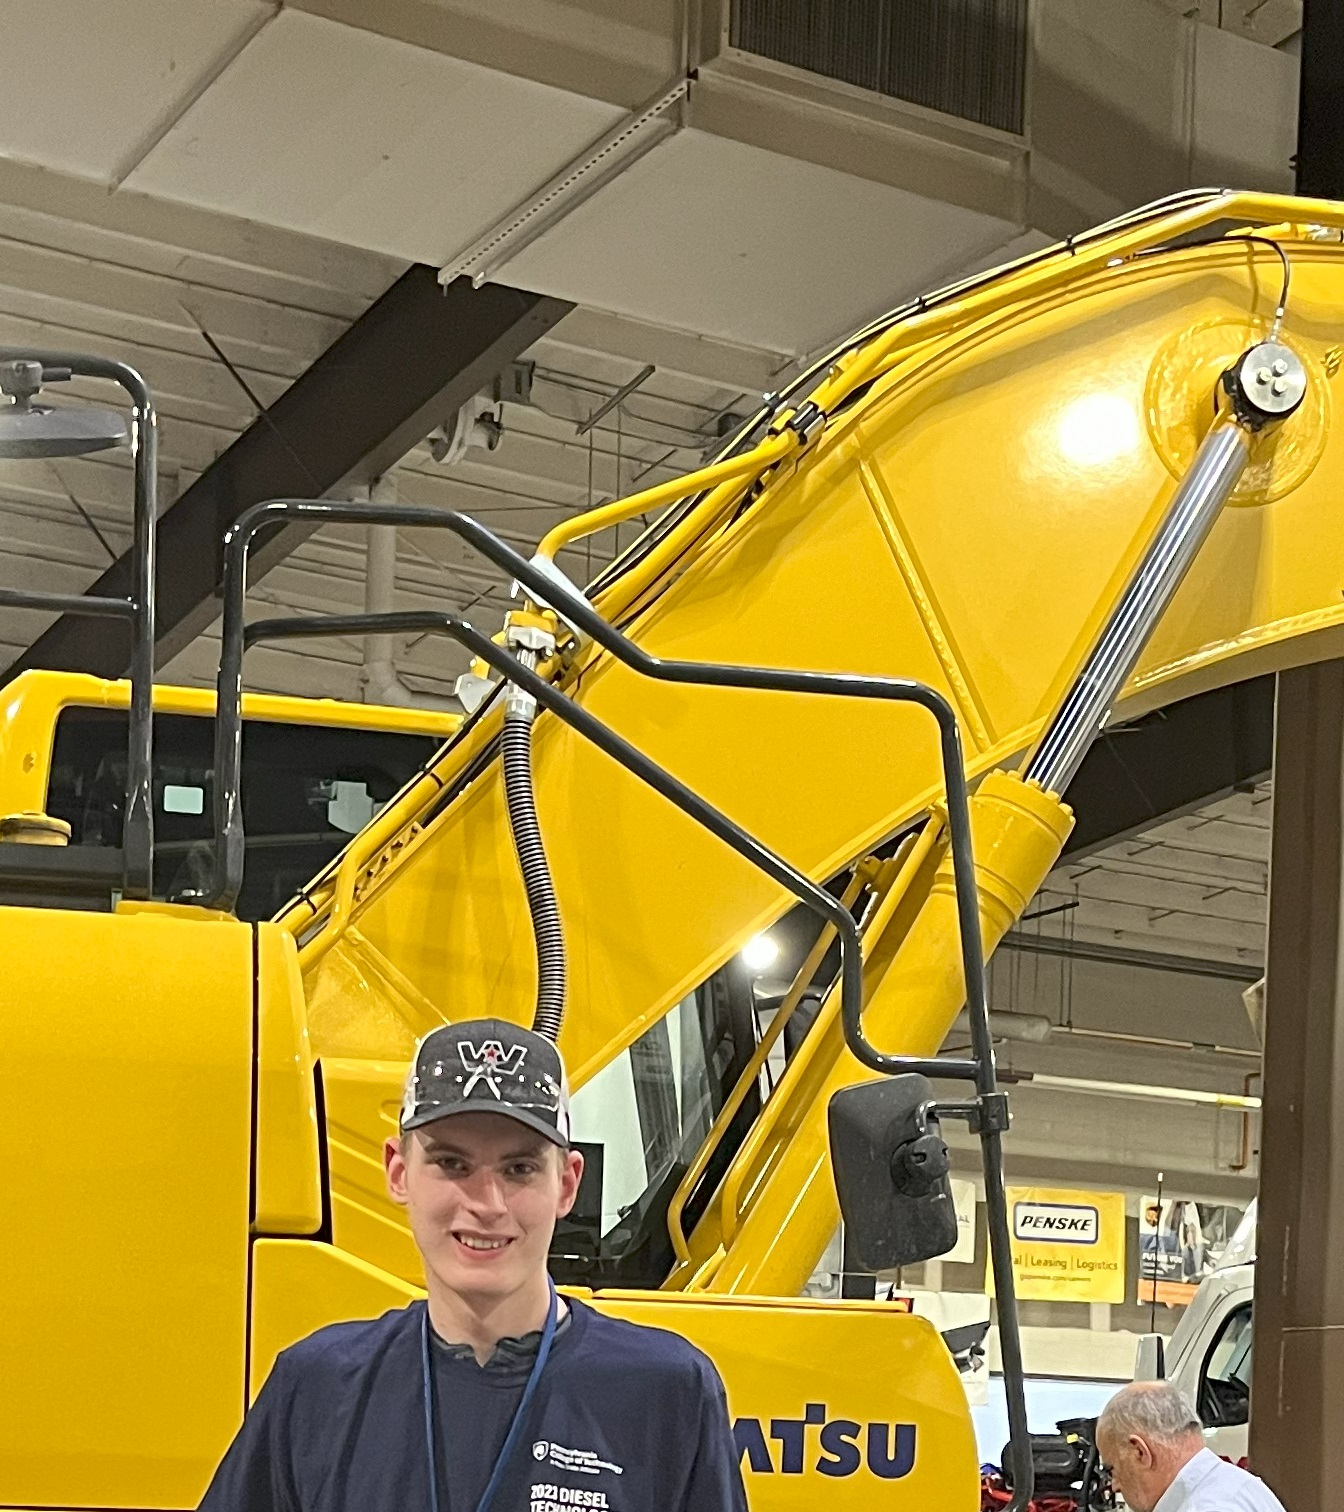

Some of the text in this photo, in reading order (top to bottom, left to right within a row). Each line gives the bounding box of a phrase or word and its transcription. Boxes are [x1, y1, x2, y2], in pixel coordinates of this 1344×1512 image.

[1020, 1215, 1093, 1232] PENSKE
[1031, 1256, 1067, 1270] Leasing
[1077, 1258, 1118, 1271] Logistics
[732, 1403, 916, 1479] ATSU
[559, 1487, 610, 1509] DIESEL
